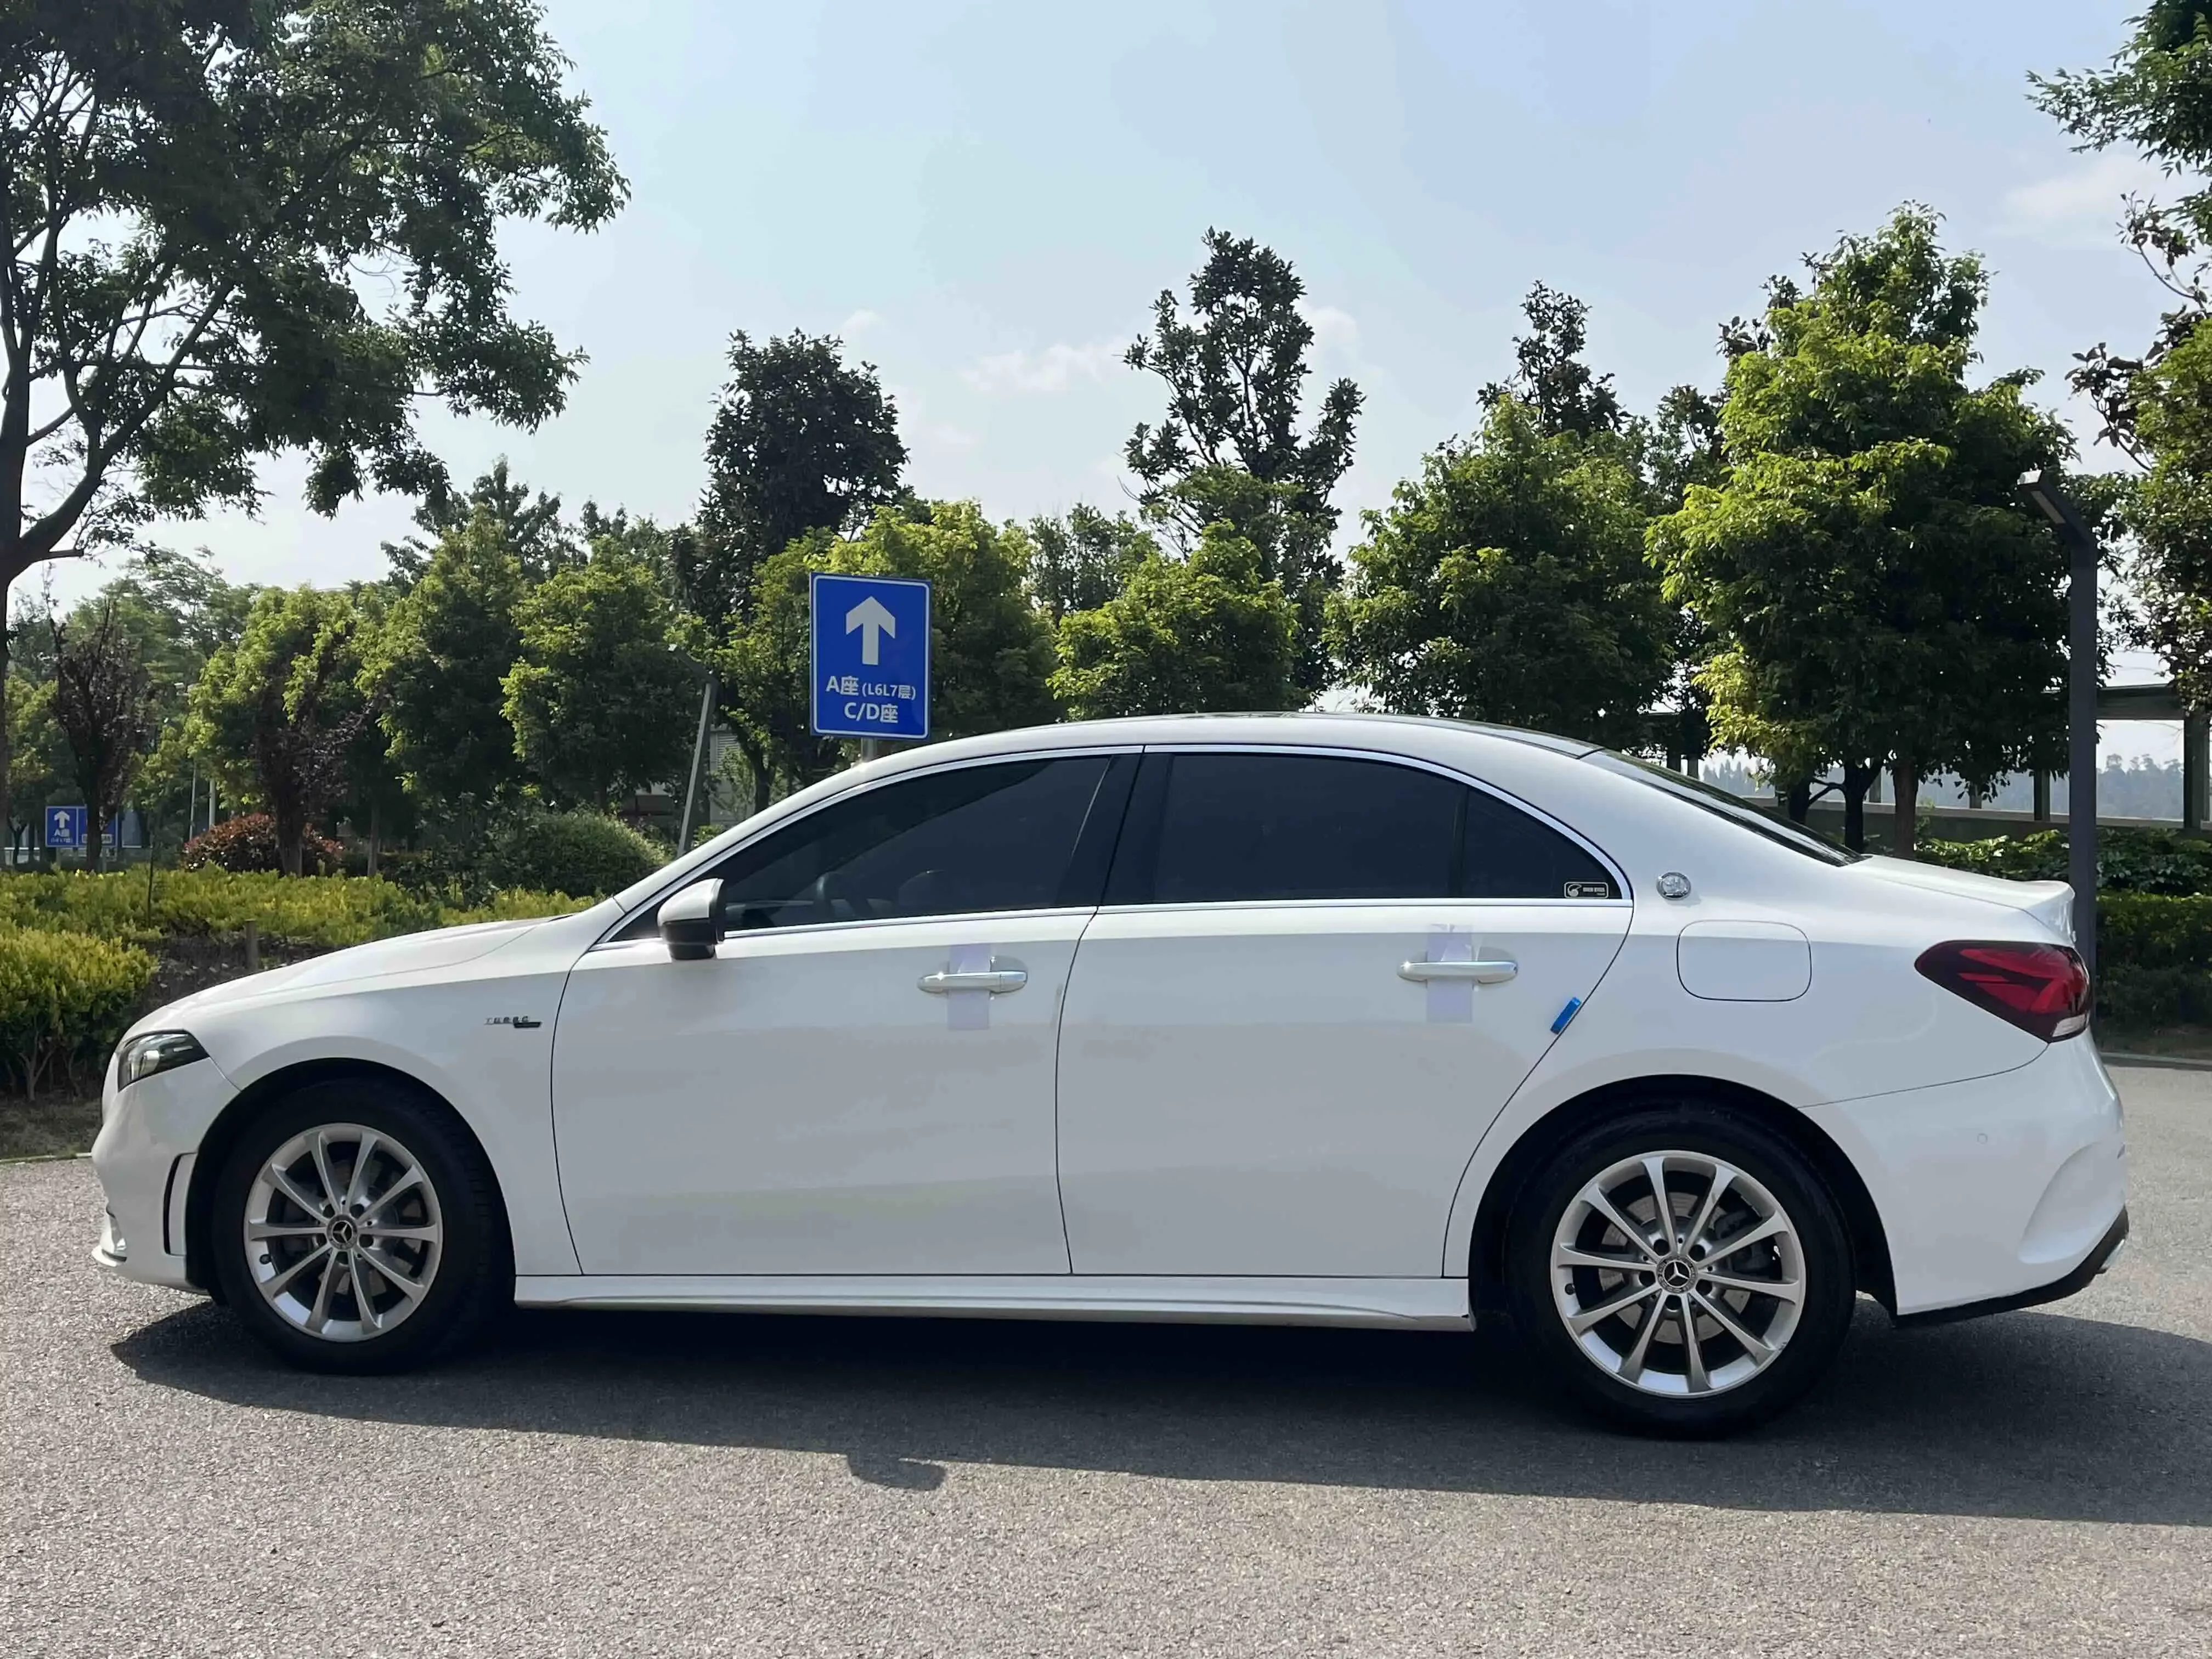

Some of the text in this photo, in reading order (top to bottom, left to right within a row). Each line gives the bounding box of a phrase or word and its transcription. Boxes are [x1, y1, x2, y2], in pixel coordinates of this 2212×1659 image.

[826, 675, 916, 701] A座 (L6L7层)
[844, 702, 899, 724] C/D座
